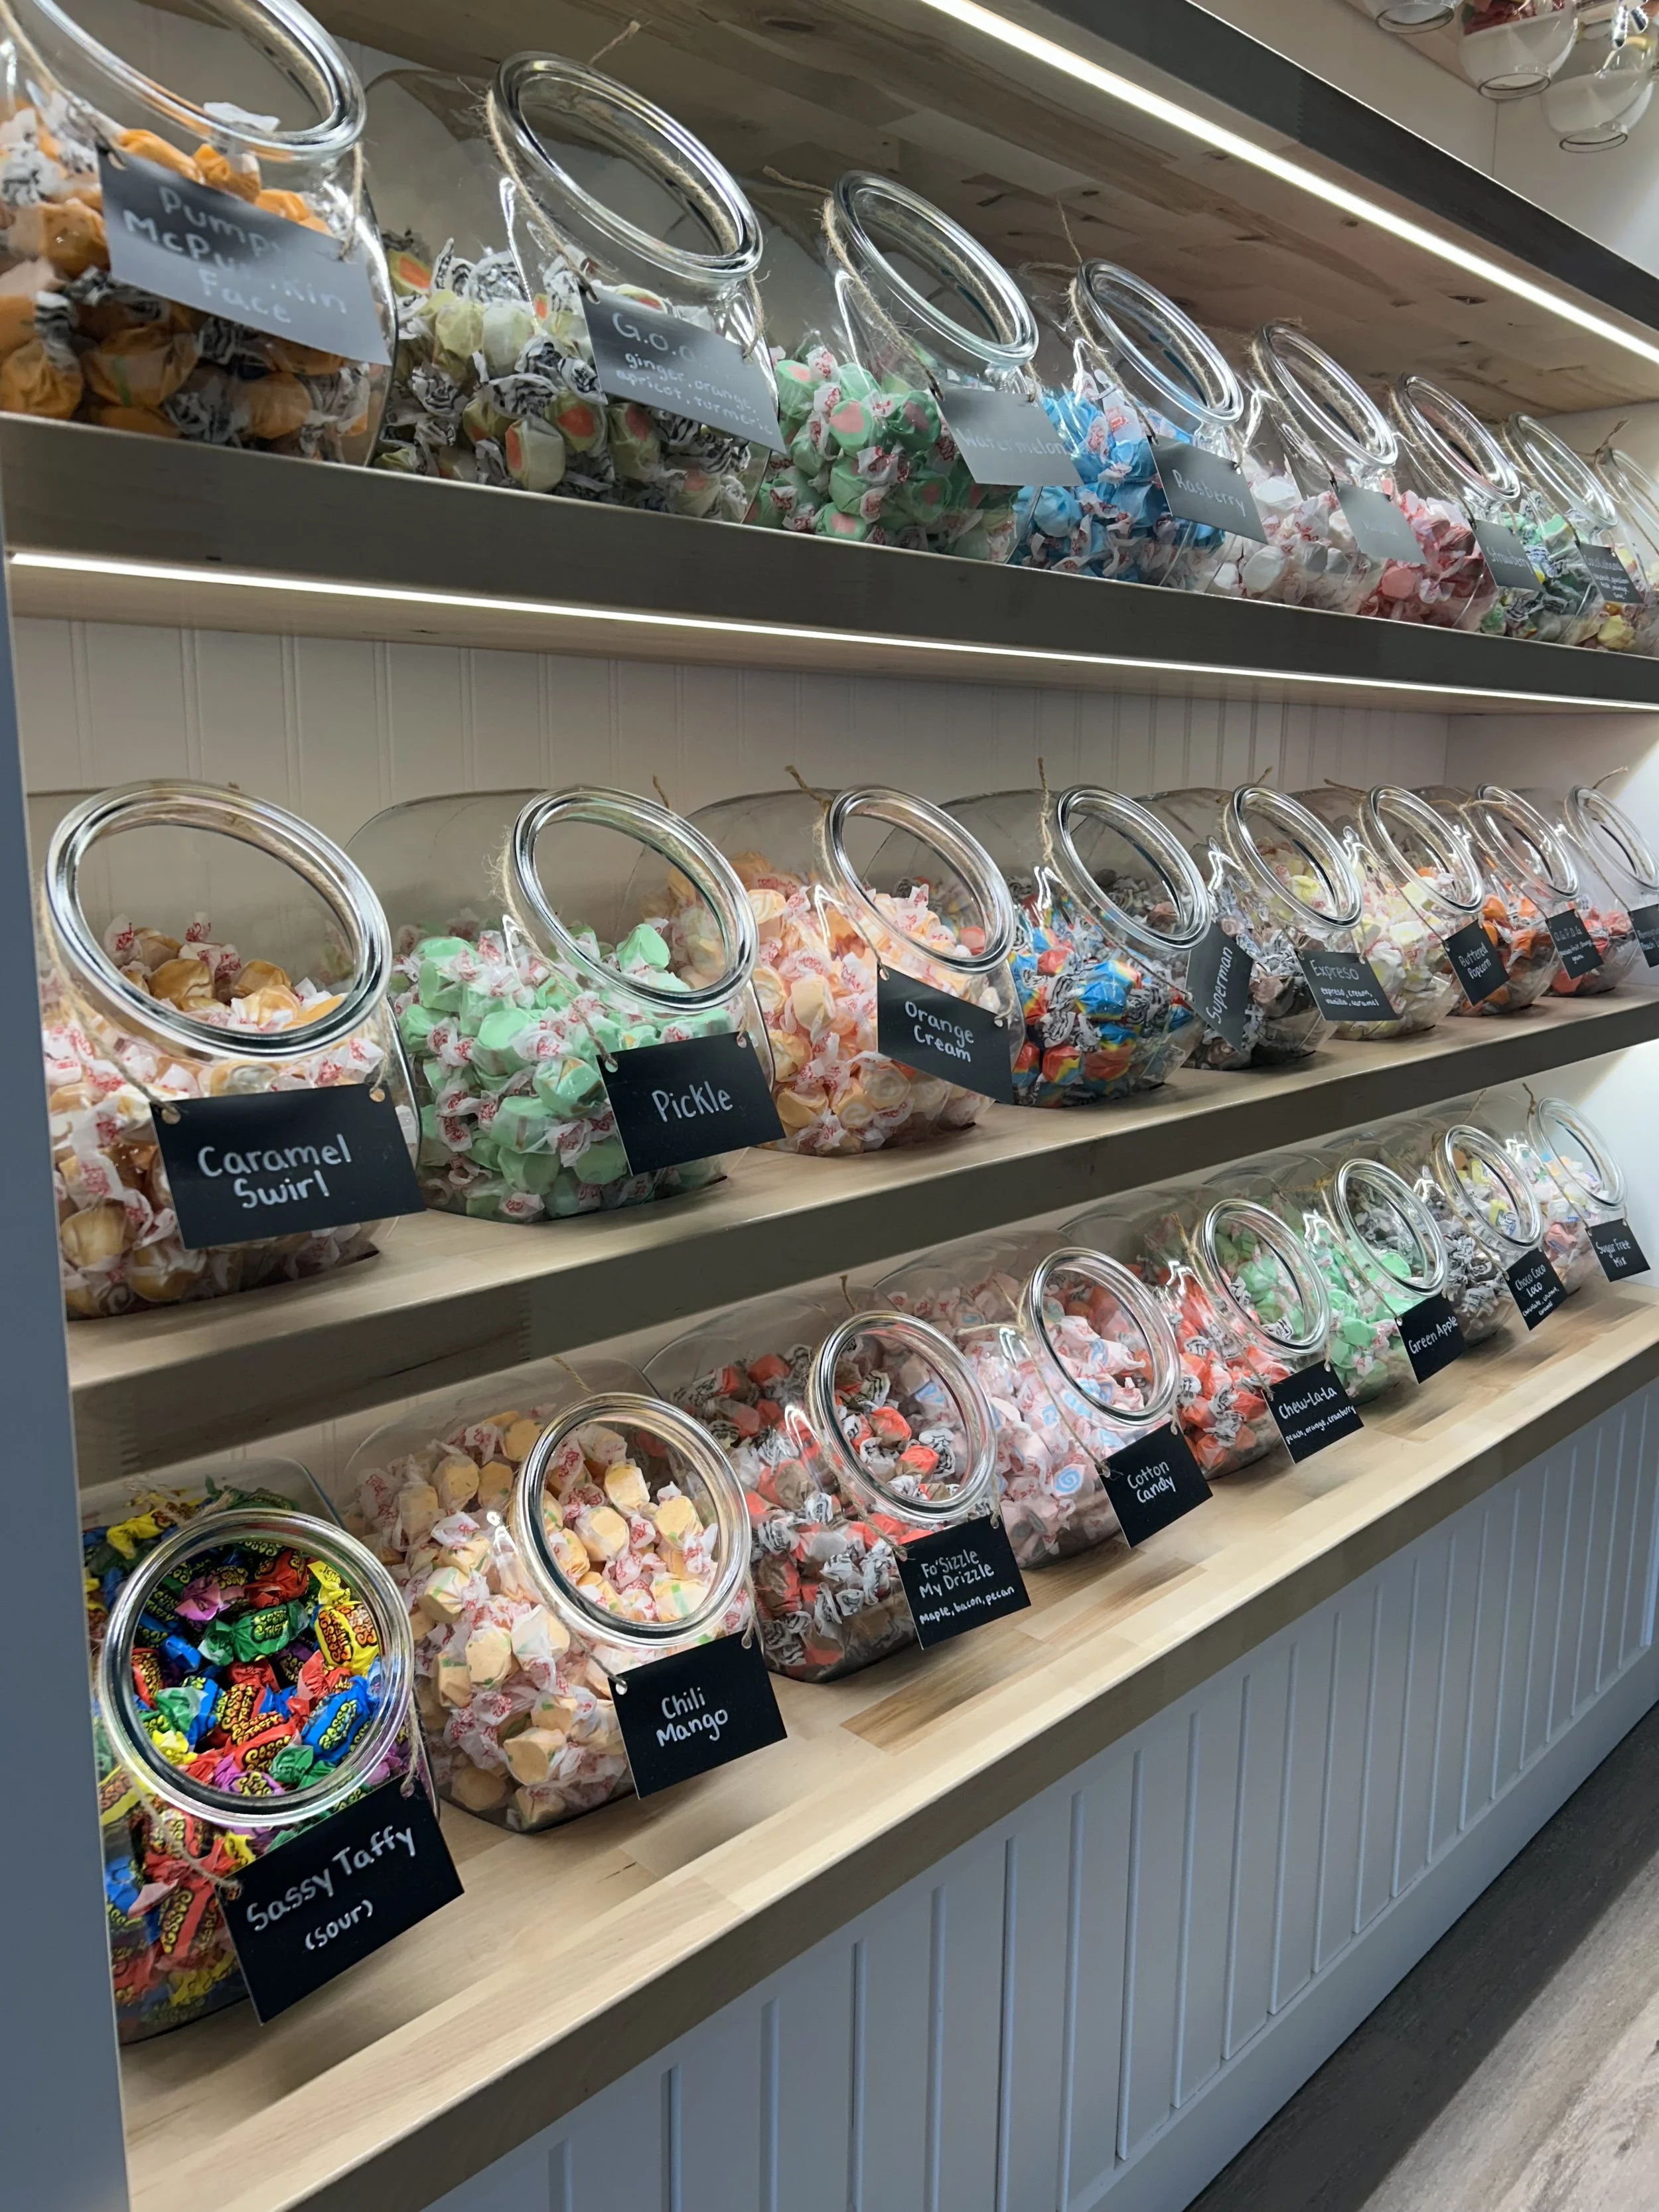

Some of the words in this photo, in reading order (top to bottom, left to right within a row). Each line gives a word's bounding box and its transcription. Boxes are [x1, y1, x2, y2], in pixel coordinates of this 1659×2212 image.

[956, 427, 1067, 455] Watermelon
[1172, 468, 1248, 517] Rasberry
[1309, 959, 1360, 982] Expreso
[1458, 942, 1488, 967] Buttered
[1467, 960, 1492, 980] Popcorn
[1206, 946, 1233, 1025] Superman
[905, 1001, 974, 1048] Orange
[914, 1025, 972, 1063] Cream
[198, 1133, 352, 1178] Caramel
[233, 1170, 331, 1209] Swirl
[1595, 1242, 1616, 1259] Sugar
[1515, 1274, 1533, 1291] Choco
[1531, 1264, 1547, 1280] Coco
[1408, 1331, 1438, 1355] Green
[1435, 1315, 1459, 1337] Apple
[1285, 1430, 1307, 1445] peach,
[1327, 1405, 1357, 1425] cranberry
[1127, 1461, 1170, 1490] Cotton
[1137, 1476, 1177, 1504] Candy
[919, 1582, 943, 1599] My
[943, 1563, 995, 1591] Drizzle
[953, 1595, 985, 1613] bacon,
[986, 1585, 1015, 1606] pecan
[662, 1686, 706, 1720] Chili
[656, 1709, 729, 1747] Mango
[246, 1868, 334, 1931] Sassy
[332, 1826, 416, 1876] Taffy
[305, 1899, 374, 1951] (sour)
